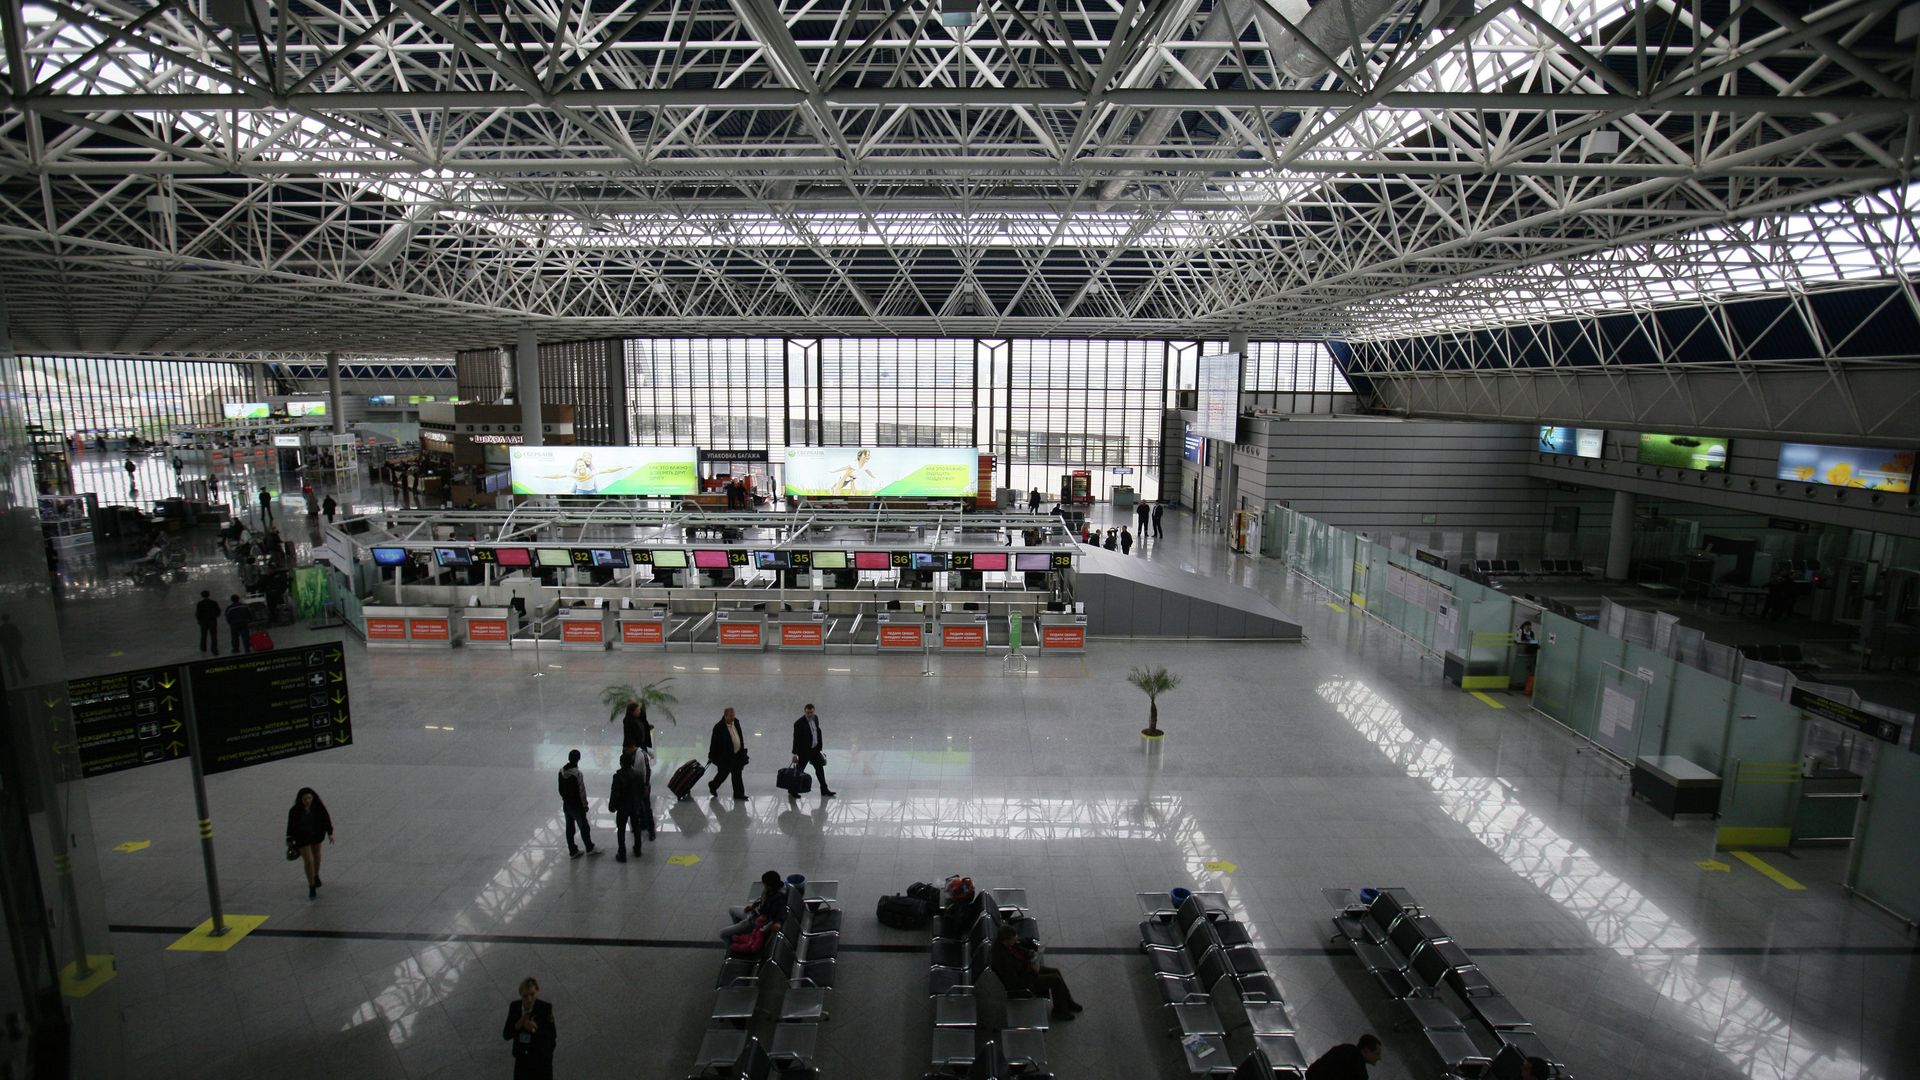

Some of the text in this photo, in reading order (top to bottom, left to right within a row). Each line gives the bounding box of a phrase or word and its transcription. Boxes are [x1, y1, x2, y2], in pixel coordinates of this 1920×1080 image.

[706, 452, 761, 460] УПАКОВКА БАГАЖА
[478, 551, 494, 561] 31
[574, 552, 589, 561] 32
[634, 552, 649, 562] 33
[732, 553, 747, 563] 34
[793, 553, 809, 563] 35
[893, 555, 908, 564] 36
[954, 556, 969, 565] 37
[1055, 556, 1070, 566] 38
